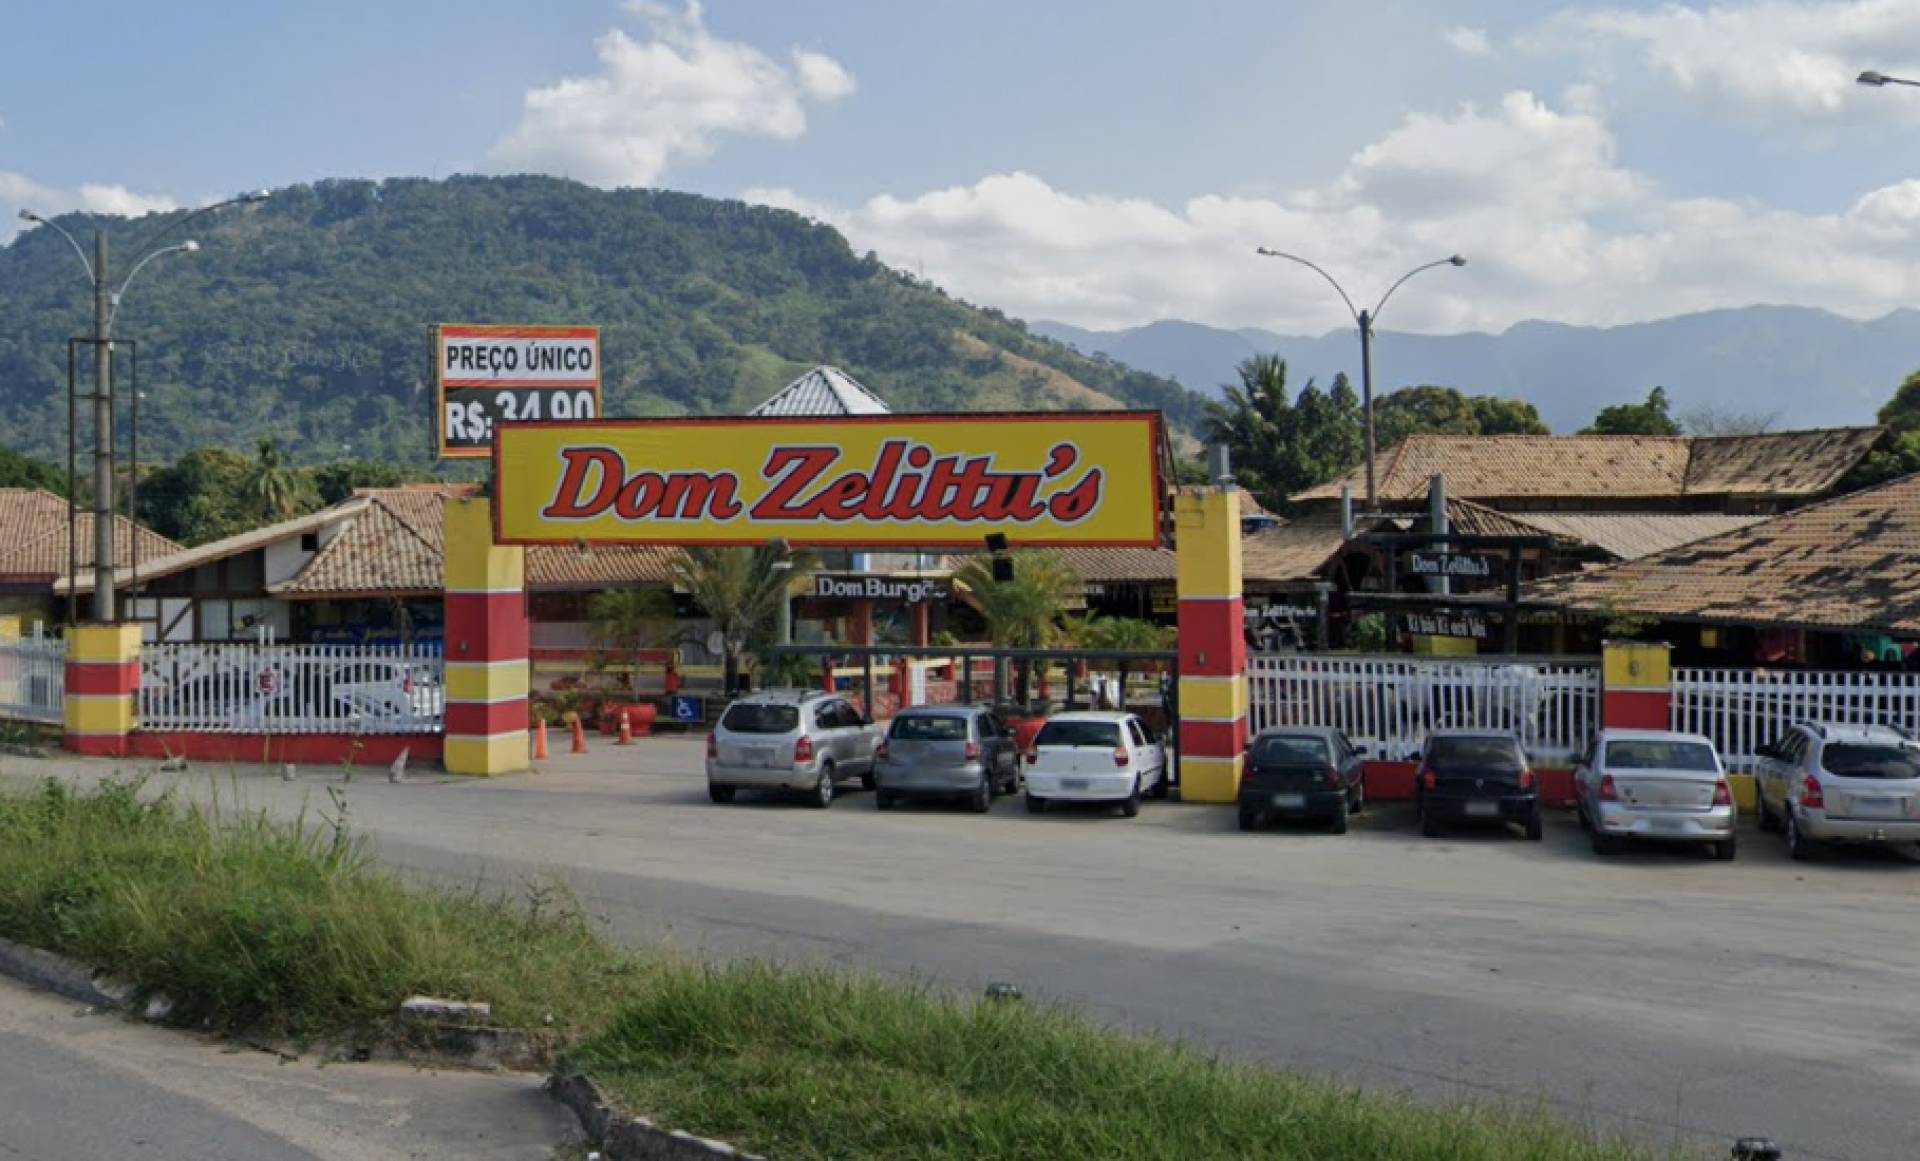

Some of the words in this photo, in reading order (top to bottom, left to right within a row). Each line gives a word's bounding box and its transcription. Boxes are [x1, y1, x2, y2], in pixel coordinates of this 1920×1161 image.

[447, 345, 519, 377] PREÇO
[526, 341, 592, 371] ÚNICO
[446, 399, 493, 444] R$:
[541, 446, 744, 519] Dom
[749, 440, 1102, 522] Zelittu's
[818, 577, 863, 597] Dom
